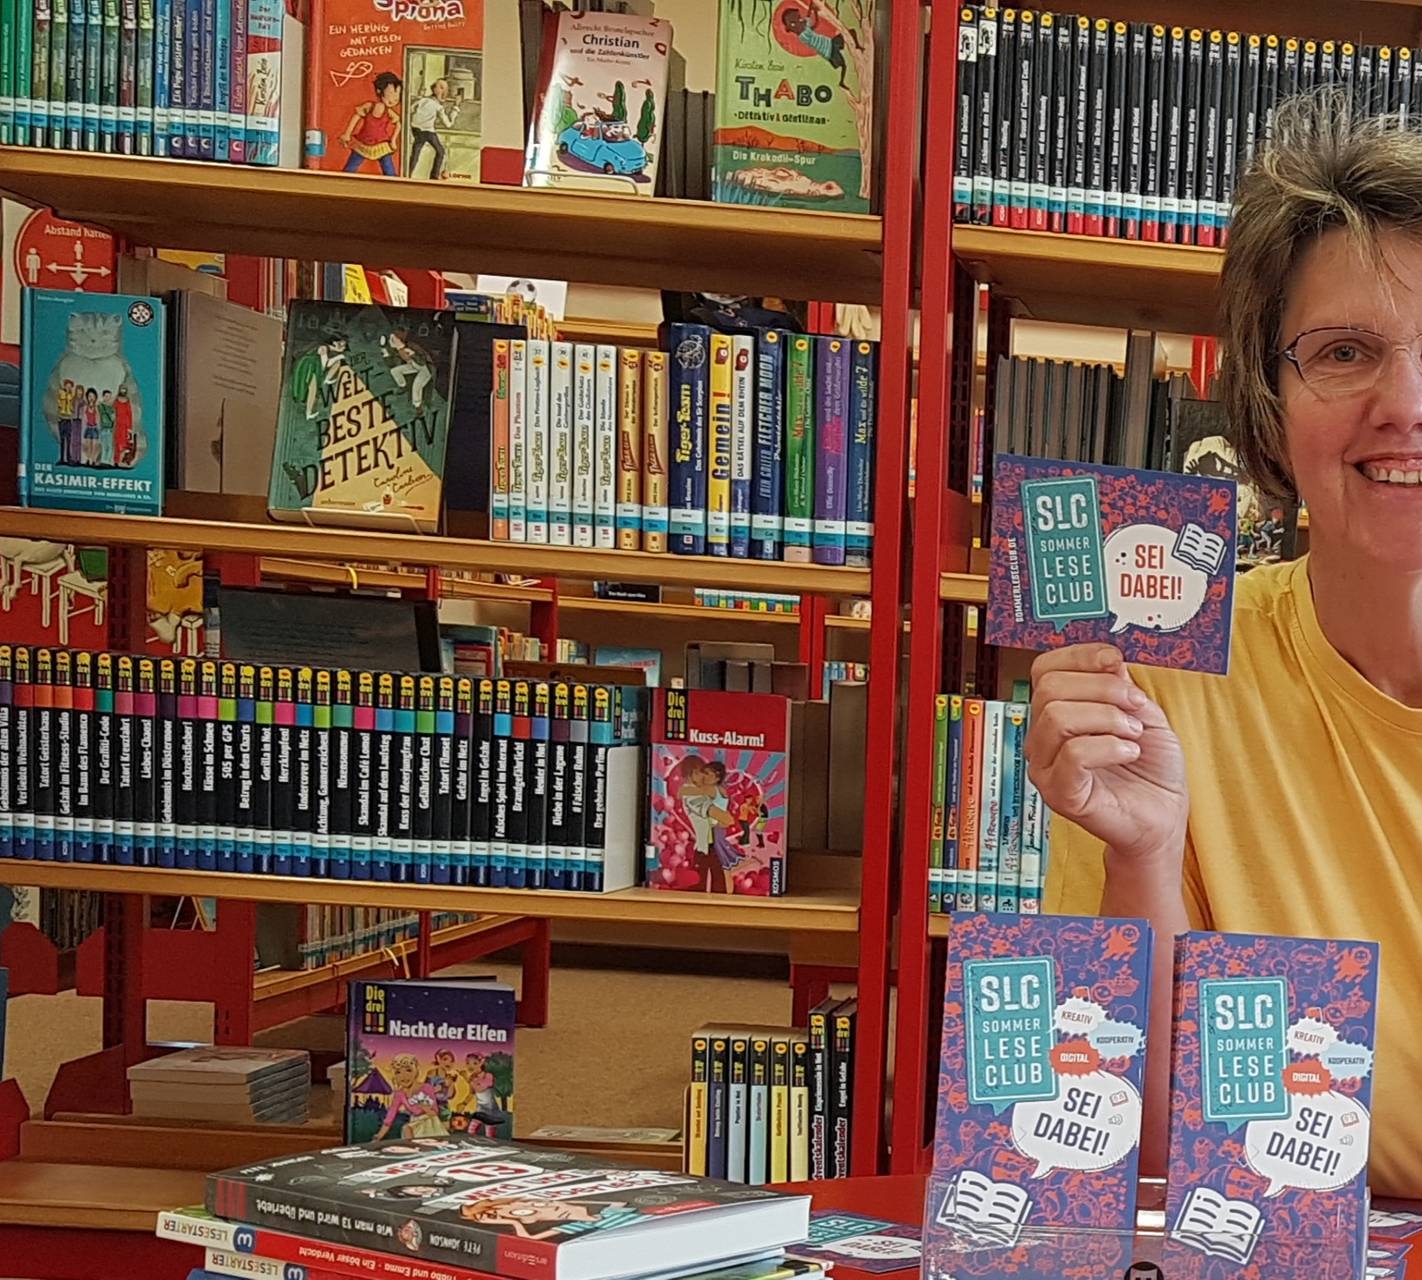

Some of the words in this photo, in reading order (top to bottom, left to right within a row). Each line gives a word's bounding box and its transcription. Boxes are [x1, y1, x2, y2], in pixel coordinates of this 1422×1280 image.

[351, 24, 390, 33] HERING
[583, 34, 639, 48] Christian
[735, 76, 832, 107] THABO
[733, 151, 748, 160] Die
[44, 224, 81, 236] Abstand
[316, 391, 395, 451] BESTE
[758, 392, 773, 445] FLETCHER
[300, 409, 440, 500] DETEKTIV
[736, 437, 744, 461] RÄTSEL
[34, 463, 52, 471] DER
[34, 473, 152, 492] KASIMIR-EFFEKT
[1037, 493, 1088, 532] SLC
[1040, 537, 1090, 552] SOMMER
[1043, 555, 1091, 578] LESE
[1135, 545, 1164, 568] SEI
[1046, 581, 1093, 604] CLUB
[1120, 574, 1182, 599] DABEI!
[668, 692, 685, 706] Die
[668, 707, 685, 718] drei
[39, 711, 49, 761] Geisterhaus
[60, 712, 69, 772] Fitness-Studio
[100, 716, 110, 768] Graffiti-Code
[204, 723, 214, 752] Schnee
[222, 725, 232, 742] GPS
[240, 725, 250, 752] Charts
[261, 728, 271, 742] Not
[299, 730, 309, 749] Netz
[690, 729, 764, 746] Kuss-Alarm!
[162, 721, 172, 768] Düstermoor
[224, 744, 234, 759] per
[204, 754, 214, 764] im
[240, 754, 250, 769] den
[261, 752, 271, 780] Gorilla
[299, 751, 309, 760] im
[400, 736, 412, 793] Meerjungfrau
[39, 763, 49, 788] Tatort
[60, 774, 69, 784] im
[100, 769, 110, 784] Der
[162, 770, 171, 780] im
[204, 766, 214, 791] Küsse
[222, 761, 232, 778] SOS
[240, 780, 251, 808] Betrug
[298, 762, 309, 810] Undercover
[60, 786, 70, 814] Gefahr
[162, 782, 172, 823] Geheimnis
[400, 795, 410, 808] der
[399, 810, 409, 829] Kuss
[366, 986, 385, 1000] Die
[979, 974, 1040, 1011] SLC
[366, 1002, 384, 1012] drei
[1215, 994, 1274, 1030] SLC
[982, 1019, 1041, 1033] SOMMER
[1061, 1010, 1093, 1026] KREATIV
[390, 1020, 434, 1038] Nacht
[437, 1023, 464, 1039] der
[467, 1025, 506, 1042] Elfen
[1294, 1031, 1324, 1044] KREATIV
[984, 1036, 1042, 1059] LESE
[1217, 1038, 1274, 1051] SOMMER
[1060, 1053, 1090, 1063] DIGITAL
[1218, 1056, 1274, 1077] LESE
[985, 1064, 1042, 1086] CLUB
[1292, 1072, 1320, 1083] DIGITAL
[1063, 1088, 1102, 1119] SEI
[1219, 1083, 1275, 1105] CLUB
[1295, 1107, 1333, 1139] SEI
[1034, 1112, 1110, 1156] DABEI!
[1266, 1132, 1341, 1175] DABEI!
[299, 1209, 315, 1222] und
[342, 1218, 351, 1229] 13
[354, 1220, 374, 1232] man
[164, 1219, 228, 1241] LESESTARTER
[463, 1242, 480, 1254] PETE
[212, 1253, 278, 1276] LESESTARTER
[362, 1259, 376, 1268] Ein
